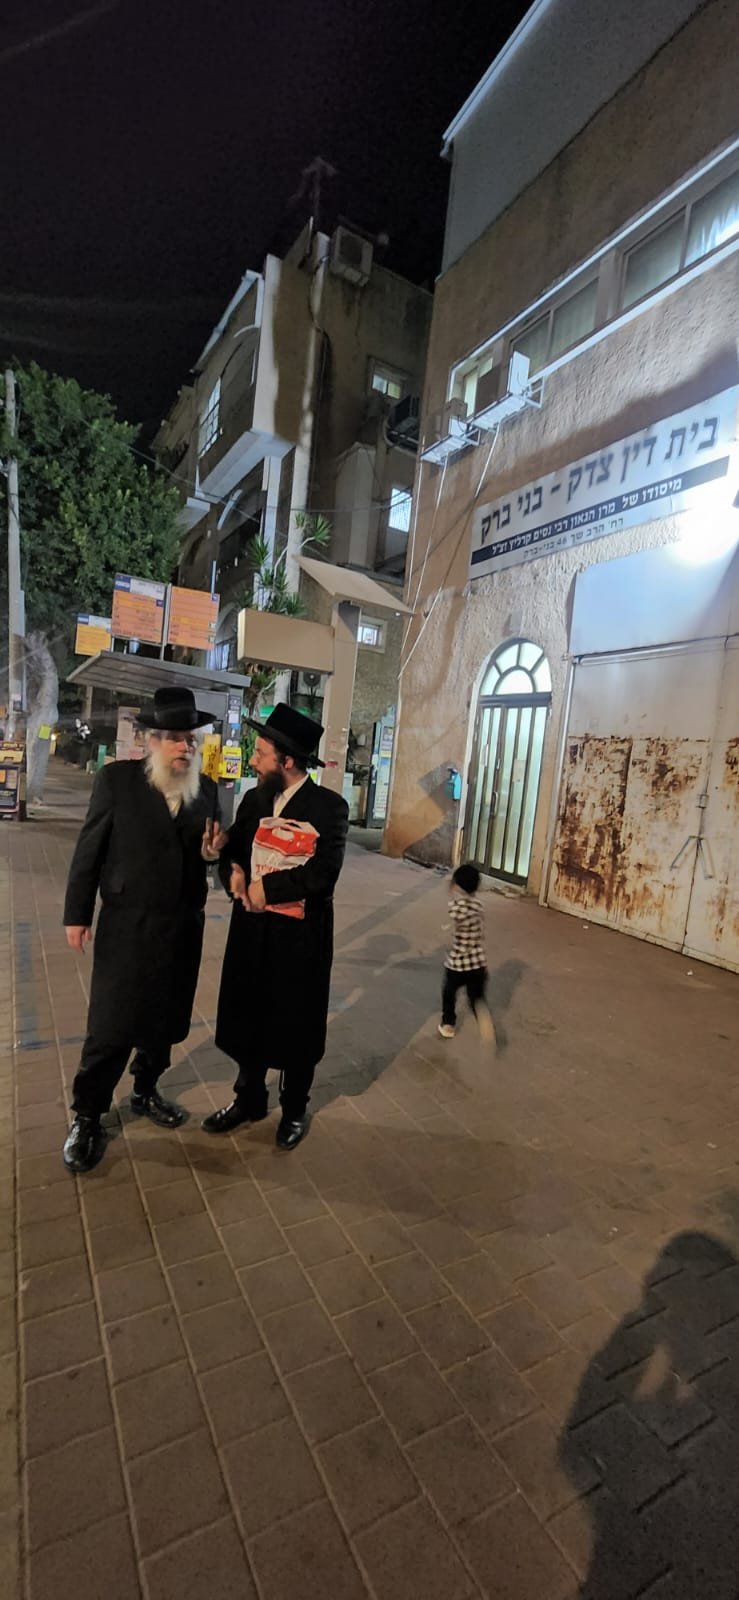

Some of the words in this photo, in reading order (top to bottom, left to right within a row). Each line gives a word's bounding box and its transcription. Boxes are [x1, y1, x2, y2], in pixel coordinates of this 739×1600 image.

[663, 417, 719, 461] בית
[620, 436, 658, 484] דין
[566, 453, 614, 503] צדק
[551, 484, 562, 494] -
[642, 478, 683, 501] מיסודו
[517, 486, 543, 517] בני
[598, 501, 616, 520] מרן
[621, 493, 639, 509] של
[480, 503, 510, 545] ברק
[553, 519, 569, 532] רבי
[570, 509, 596, 528] הגאון
[533, 526, 552, 541] נסים
[571, 531, 584, 542] שך
[586, 524, 605, 536] הרב
[510, 534, 532, 550] קרליץ
